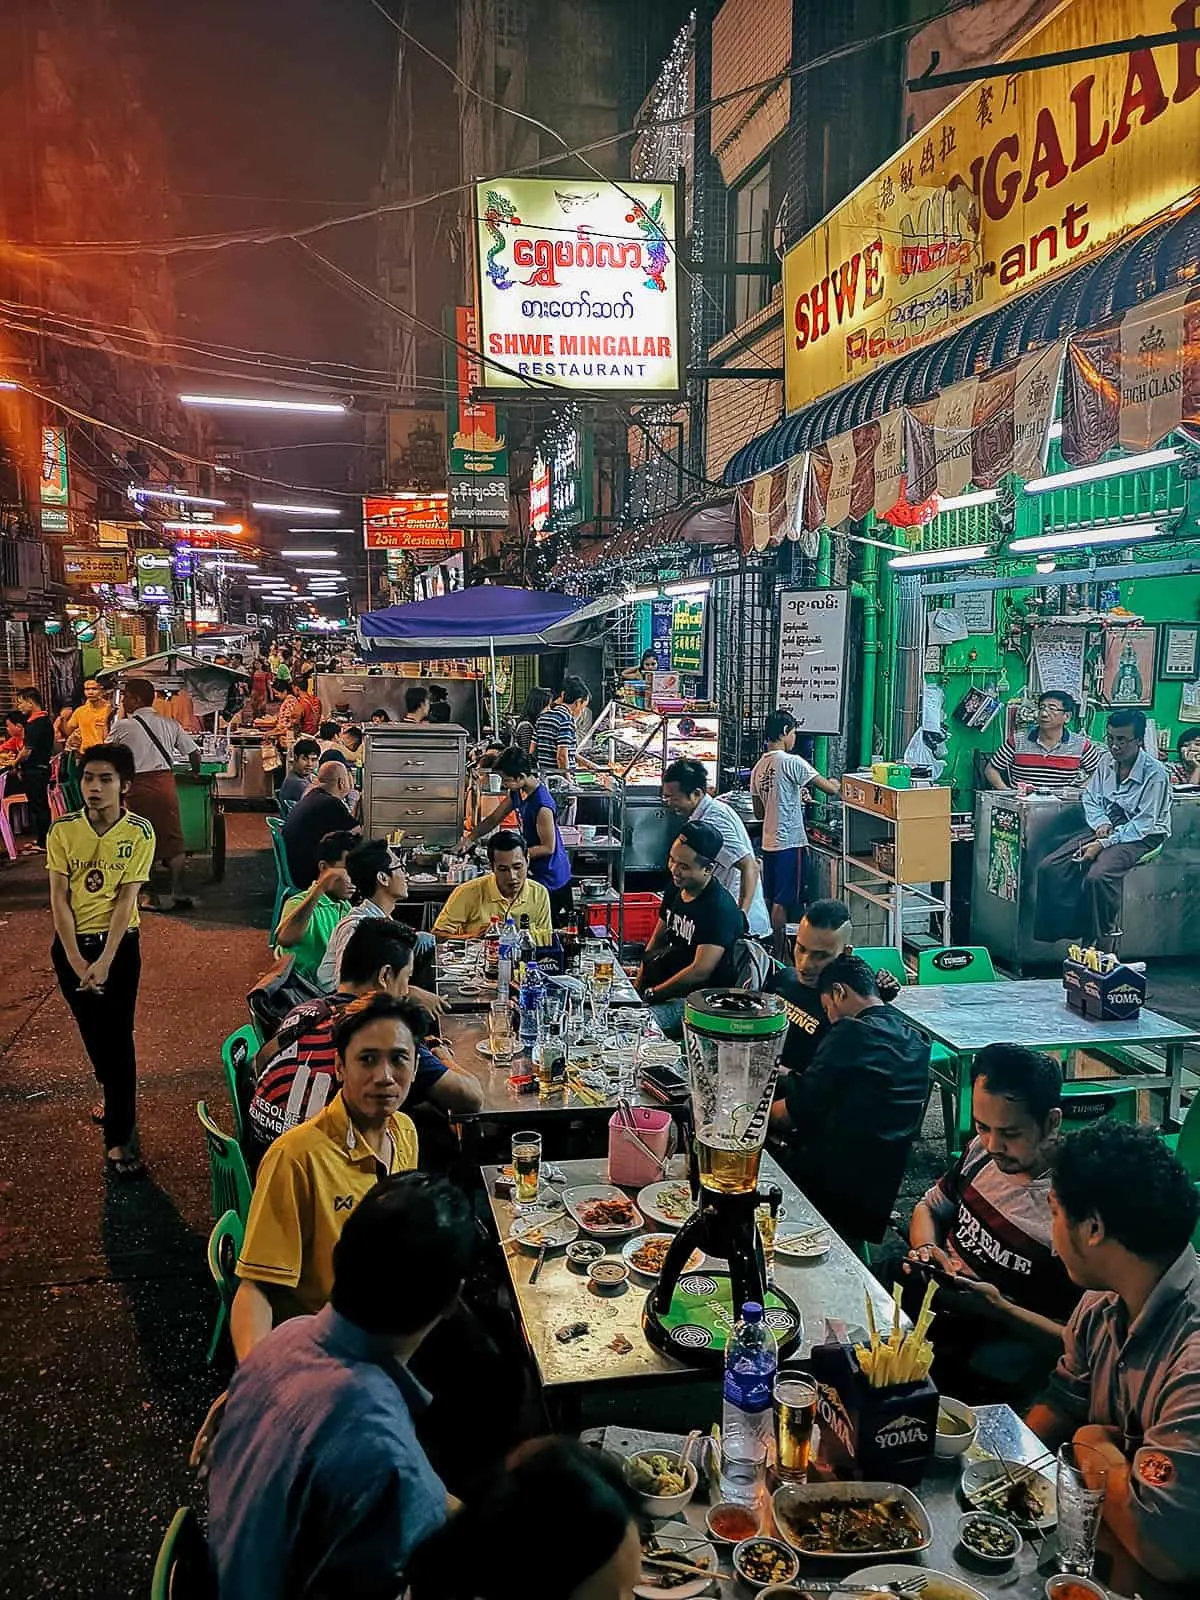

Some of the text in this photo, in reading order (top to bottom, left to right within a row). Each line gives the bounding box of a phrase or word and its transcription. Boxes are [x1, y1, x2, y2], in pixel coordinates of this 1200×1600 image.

[795, 241, 885, 351] SHWE
[488, 332, 673, 358] SHWE MINGALAR
[518, 361, 647, 377] RESTAURANT
[1122, 383, 1146, 409] HIGH
[1149, 371, 1182, 399] CLASS
[374, 532, 455, 546] Win Restaurant
[116, 845, 133, 859] 10
[1106, 993, 1143, 1005] YOMA
[957, 1203, 1033, 1276] PREME
[874, 1427, 929, 1449] YOMA
